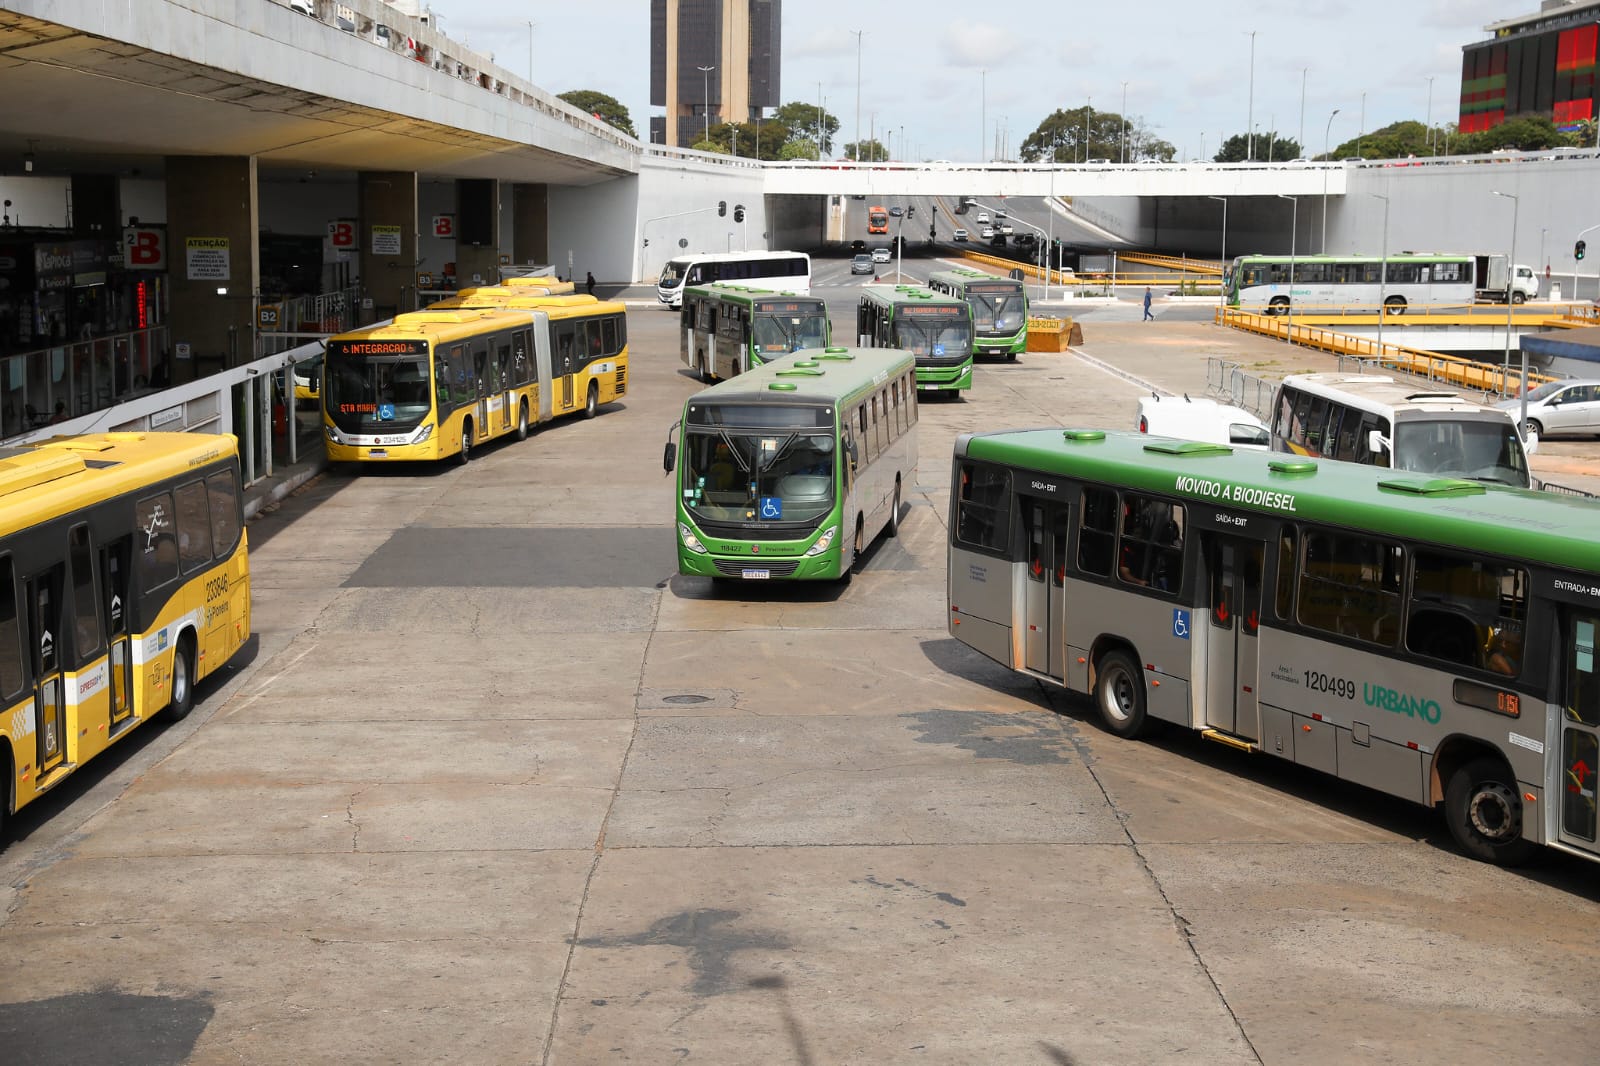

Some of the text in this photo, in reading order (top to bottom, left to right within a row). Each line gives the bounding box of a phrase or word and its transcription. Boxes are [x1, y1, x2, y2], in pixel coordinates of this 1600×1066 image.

[128, 231, 160, 264] 2 B
[329, 223, 352, 245] 3 B
[261, 311, 277, 322] B2
[1176, 476, 1297, 511] MOVIDO A BIODIESEL
[206, 572, 228, 603] 233846
[1554, 579, 1587, 594] ENTRADA
[1304, 670, 1355, 700] 120499
[1364, 682, 1442, 725] URBANO
